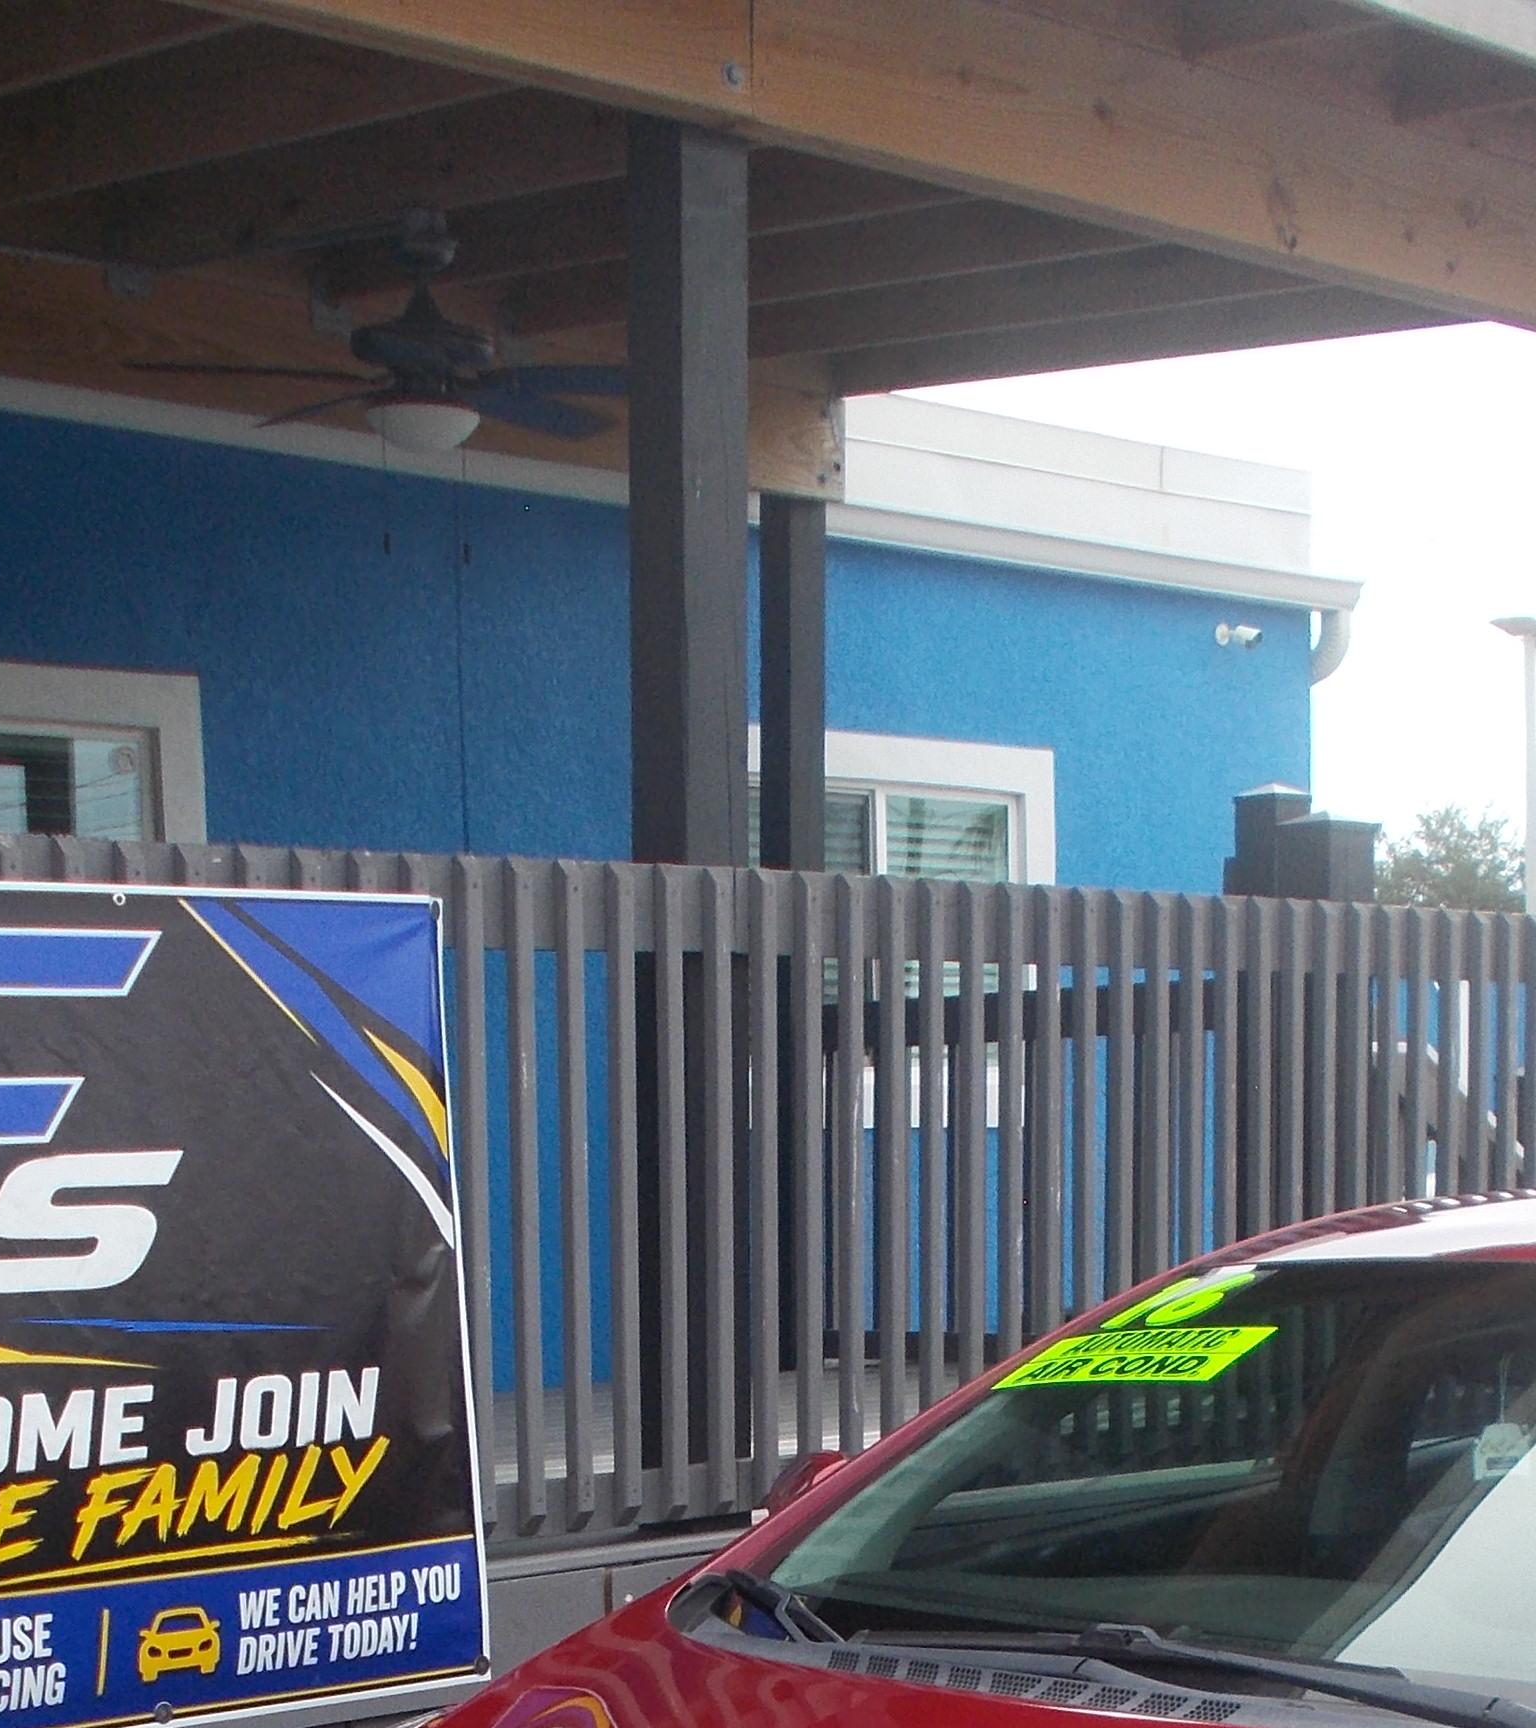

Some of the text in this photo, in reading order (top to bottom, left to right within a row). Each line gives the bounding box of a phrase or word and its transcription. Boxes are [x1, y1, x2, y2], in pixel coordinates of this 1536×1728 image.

[1015, 1355, 1208, 1382] AIR COND.
[1063, 1328, 1241, 1356] AUTOMATIC
[185, 1366, 381, 1457] JOIN
[71, 1436, 391, 1562] FAMILY
[238, 1562, 462, 1631] WE CAN HELP YOU
[235, 1612, 420, 1676] DRIVE TODAY!
